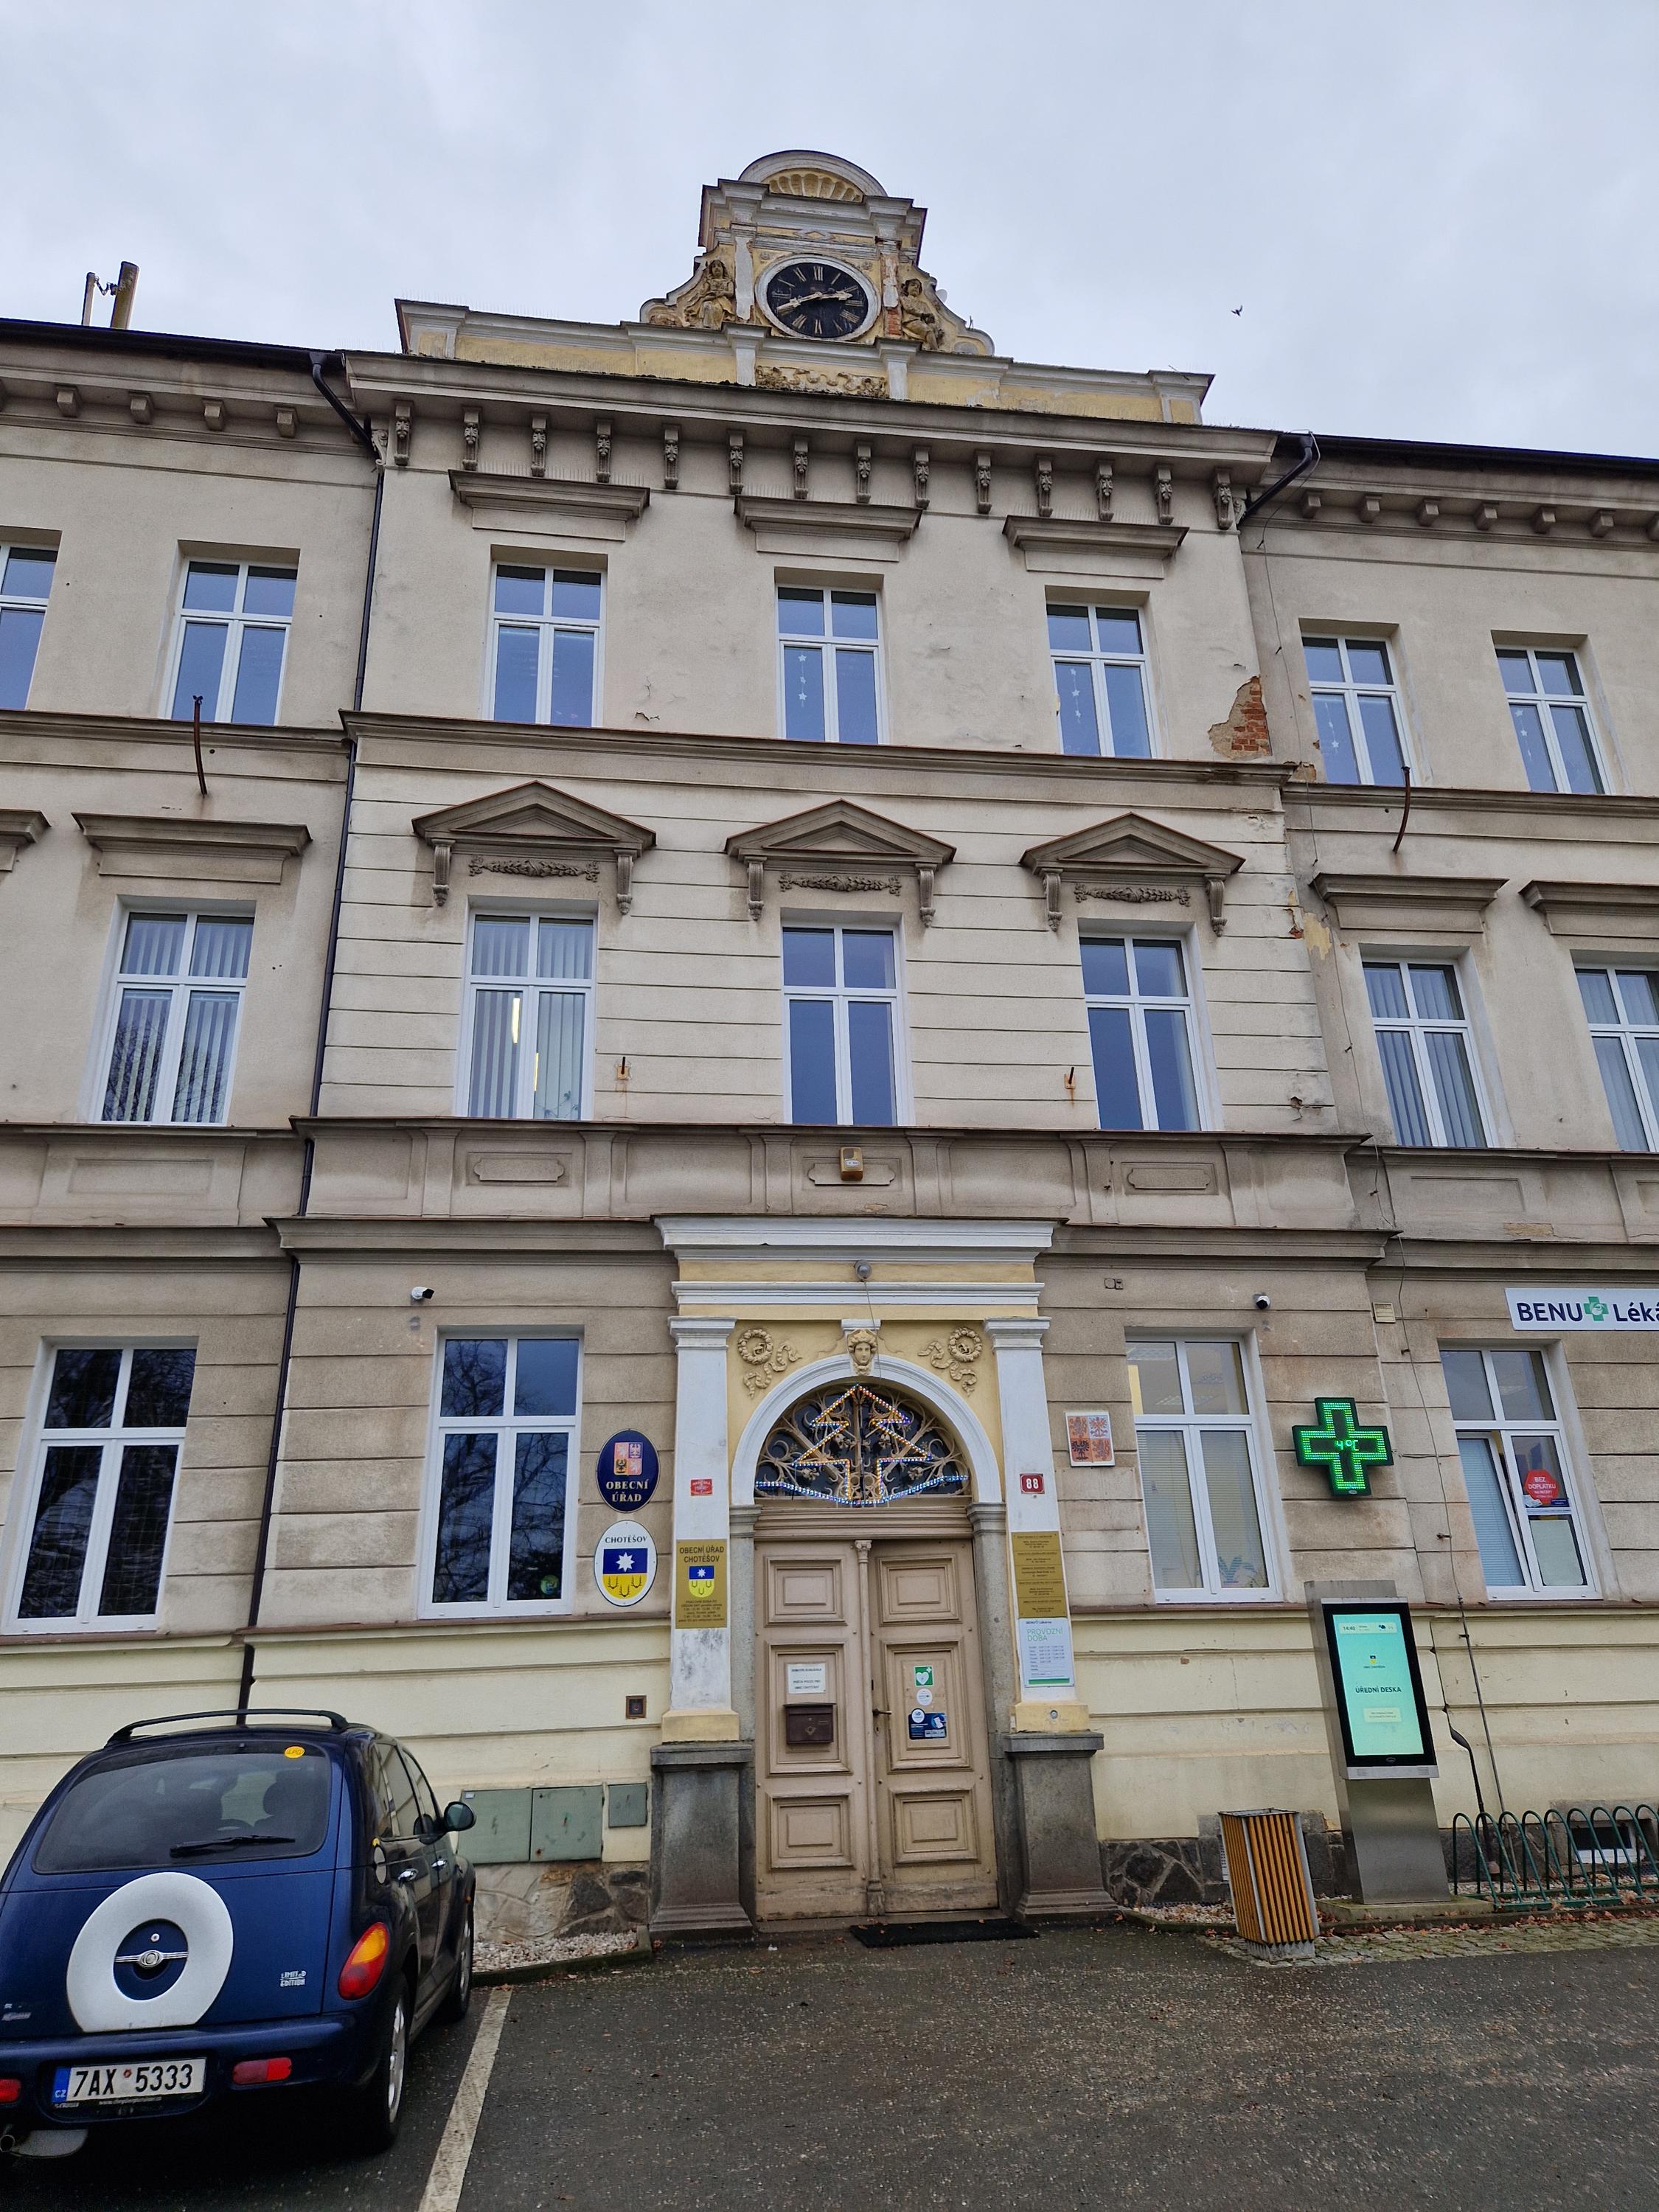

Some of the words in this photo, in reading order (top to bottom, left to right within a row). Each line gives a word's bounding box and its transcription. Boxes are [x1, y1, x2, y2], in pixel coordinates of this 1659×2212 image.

[1517, 1302, 1583, 1322] BENU
[605, 1478, 649, 1489] OBECNÍ
[1026, 1478, 1039, 1489] 88
[612, 1491, 642, 1502] ÚŘAD
[605, 1534, 648, 1543] CHOTĚŠOV
[679, 1545, 705, 1554] OBECNÍ
[706, 1545, 725, 1553] ÚŘAD
[684, 1554, 720, 1563] CHOTĚŠOV
[1026, 1627, 1063, 1635] PROVOZNÍ
[1355, 1685, 1380, 1693] ÚŘEDNÍ
[73, 2067, 117, 2098] 7AX
[135, 2064, 192, 2093] 5333
[55, 2089, 66, 2098] CZ
